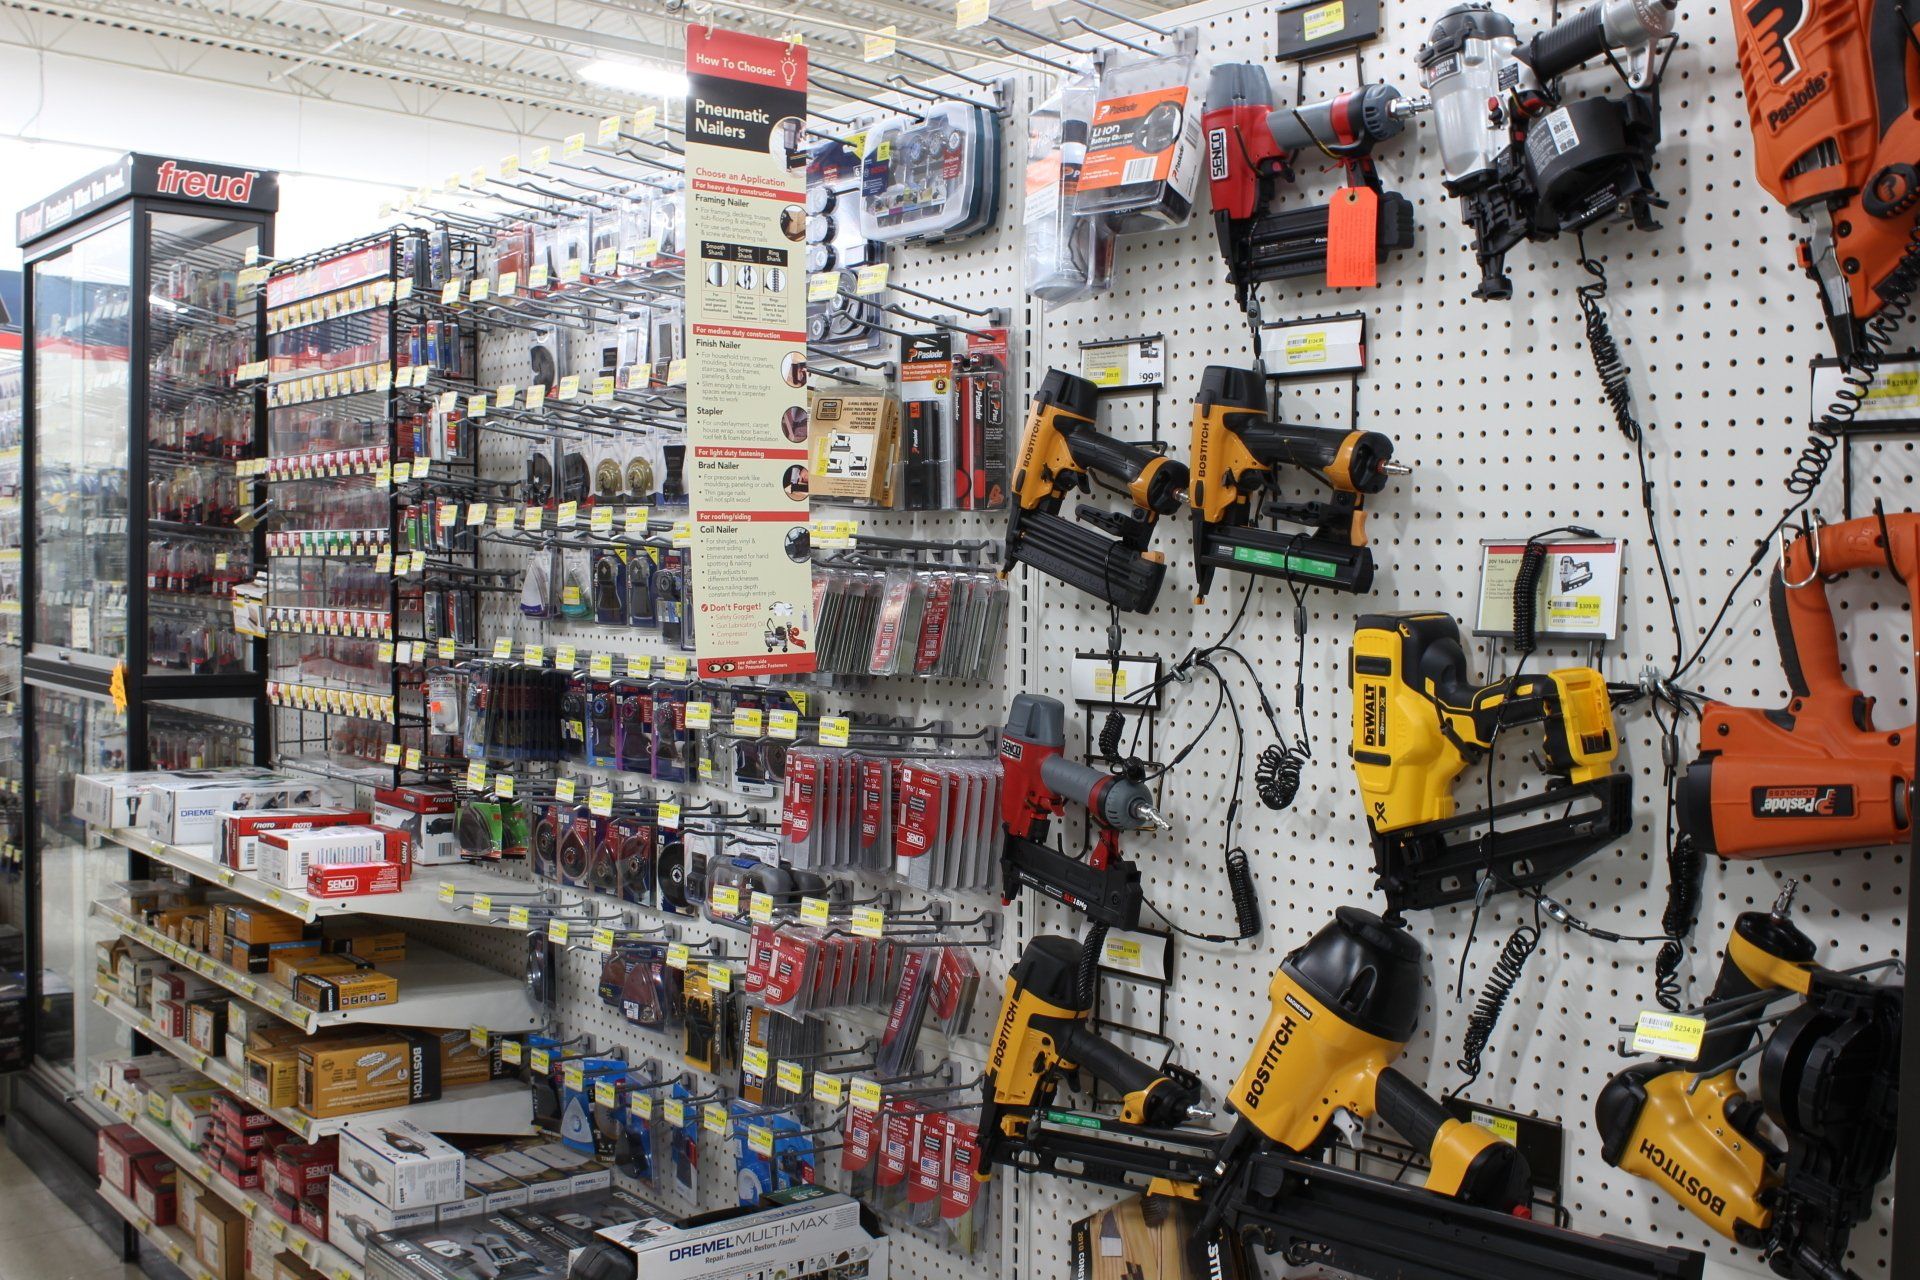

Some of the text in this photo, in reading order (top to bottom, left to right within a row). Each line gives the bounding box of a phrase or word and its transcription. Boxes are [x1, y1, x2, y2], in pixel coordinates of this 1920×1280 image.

[696, 53, 775, 76] How To Choose:
[696, 99, 769, 124] Pneumatic
[1767, 77, 1826, 131] Paslode
[696, 118, 745, 139] Nailers
[1211, 132, 1220, 177] SENCO
[157, 161, 254, 203] freud
[696, 168, 726, 178] Choose
[741, 174, 785, 187] Application
[707, 183, 724, 191] heavy
[726, 185, 739, 194] duty
[741, 188, 776, 198] construction
[696, 194, 749, 207] Framing Nailer
[732, 329, 745, 337] duty
[696, 339, 741, 349] Finish Nailer
[917, 349, 943, 359] Paslode
[697, 407, 723, 416] Stapler
[1023, 418, 1042, 468] BOSTITCH
[1198, 422, 1210, 478] BOSTITCH
[710, 450, 723, 458] light
[724, 450, 737, 458] duty
[739, 450, 764, 459] fastening
[712, 513, 751, 521] roofing/siding
[710, 603, 761, 612] Don't Forget!
[1002, 740, 1021, 756] SENCO
[1375, 802, 1387, 824] XR
[1764, 798, 1815, 812] Paslode
[907, 832, 923, 846] SENCO
[327, 878, 355, 891] SENCO
[744, 1009, 752, 1045] OSTITCH
[994, 1001, 1018, 1067] BOSTITCH
[1246, 1016, 1297, 1110] BOSTITCH
[413, 1047, 422, 1098] BOSTITCH
[249, 1136, 264, 1146] SEN
[306, 1165, 333, 1179] SENCO
[1639, 1138, 1726, 1216] BOSTITCH
[534, 1187, 556, 1195] DREMEL
[489, 1196, 512, 1204] DREMEL
[670, 1214, 828, 1262] DREMEL MULTI-MAX
[705, 1236, 798, 1264] Repair. Remodel. Restore. Faster.
